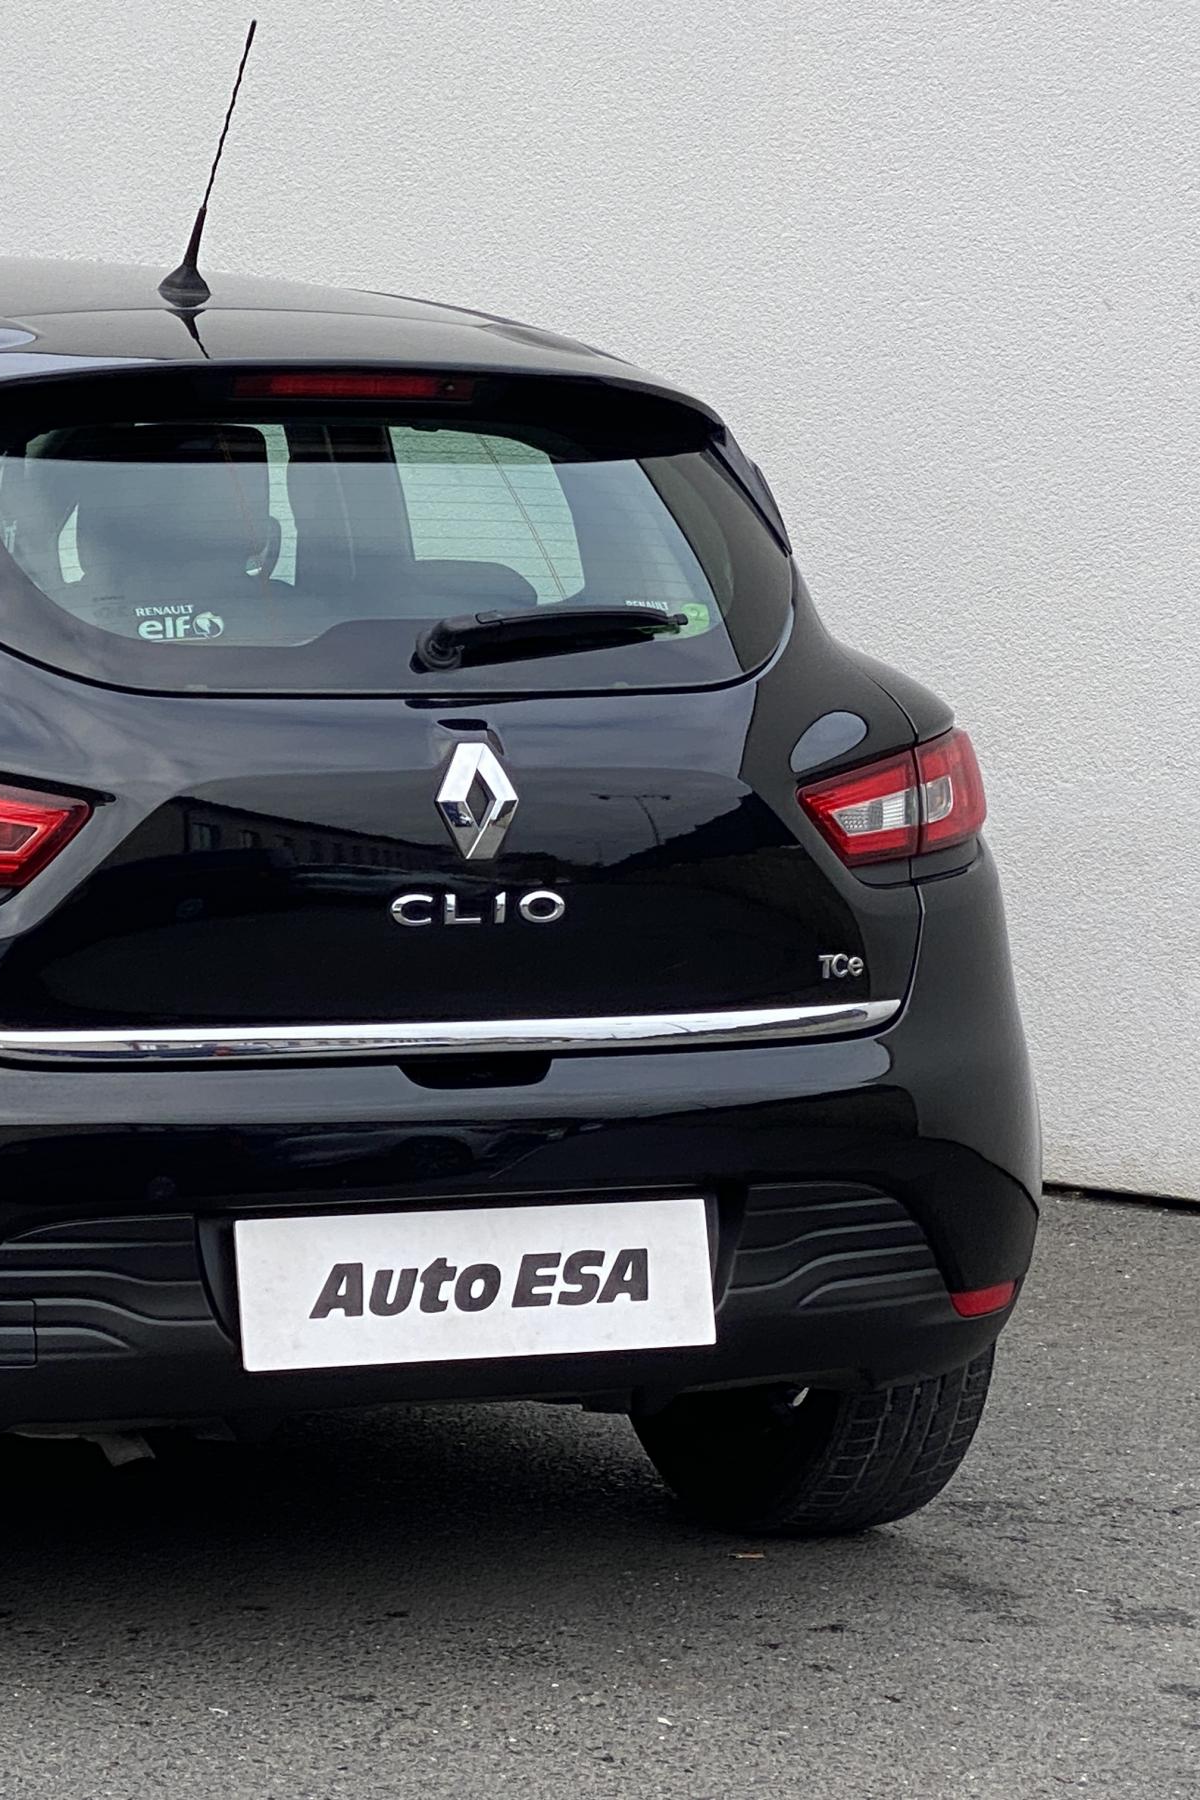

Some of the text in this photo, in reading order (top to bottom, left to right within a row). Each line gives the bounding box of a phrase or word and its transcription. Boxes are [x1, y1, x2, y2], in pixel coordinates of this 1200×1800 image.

[135, 604, 194, 617] RENAULT
[138, 615, 191, 640] elf
[390, 890, 566, 927] CLIO
[818, 953, 864, 979] TCe
[309, 1247, 649, 1319] Auto ESA
